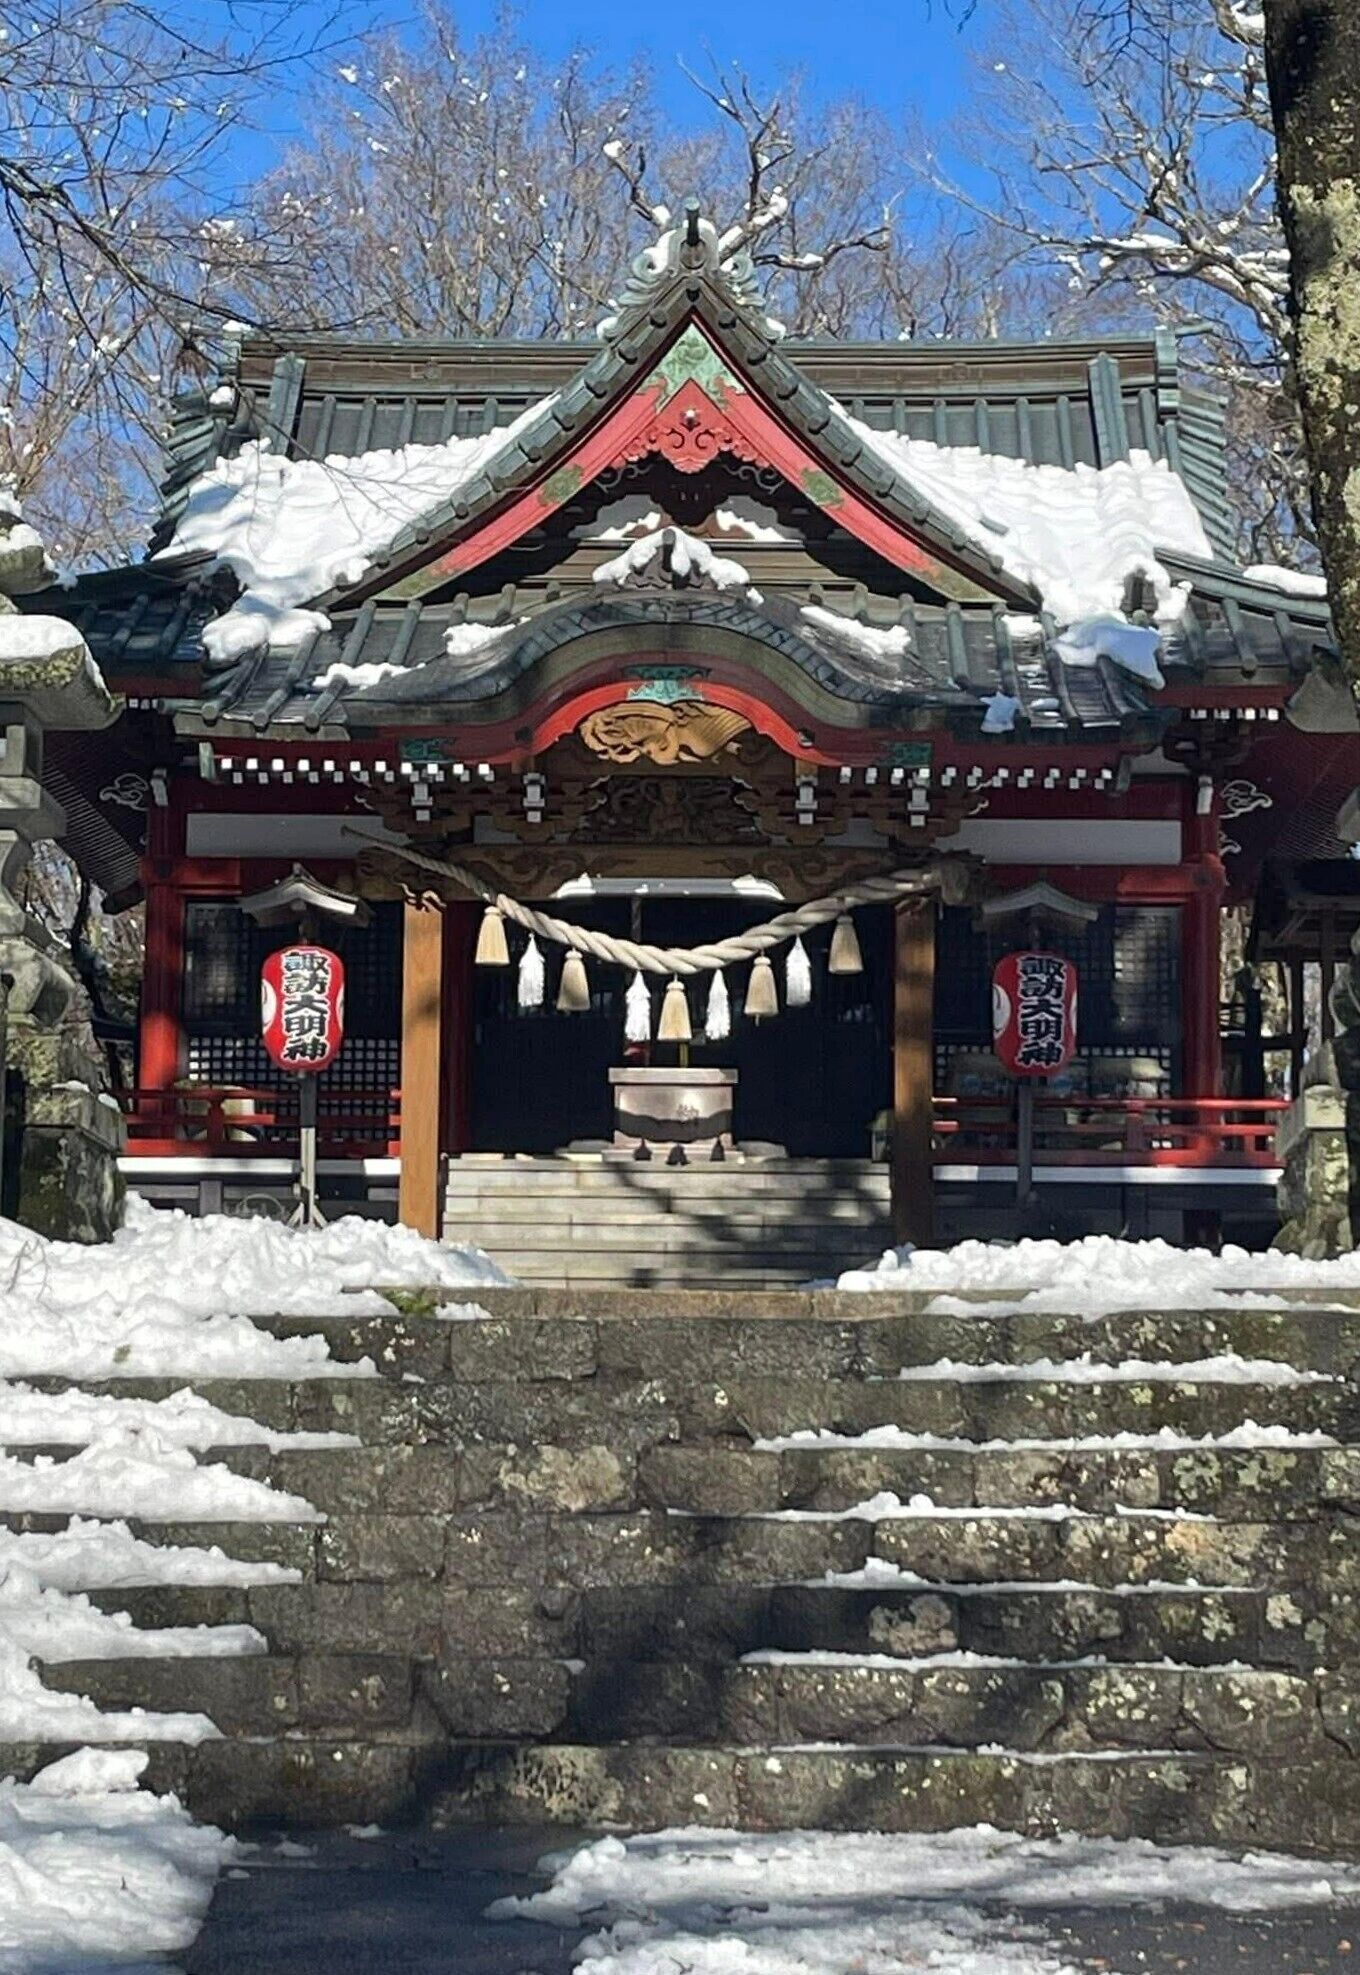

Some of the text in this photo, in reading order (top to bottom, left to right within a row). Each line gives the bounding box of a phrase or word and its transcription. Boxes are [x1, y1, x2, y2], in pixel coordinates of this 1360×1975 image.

[283, 951, 330, 1061] 諏訪大明神
[1018, 956, 1065, 1066] 諏訪大明神
